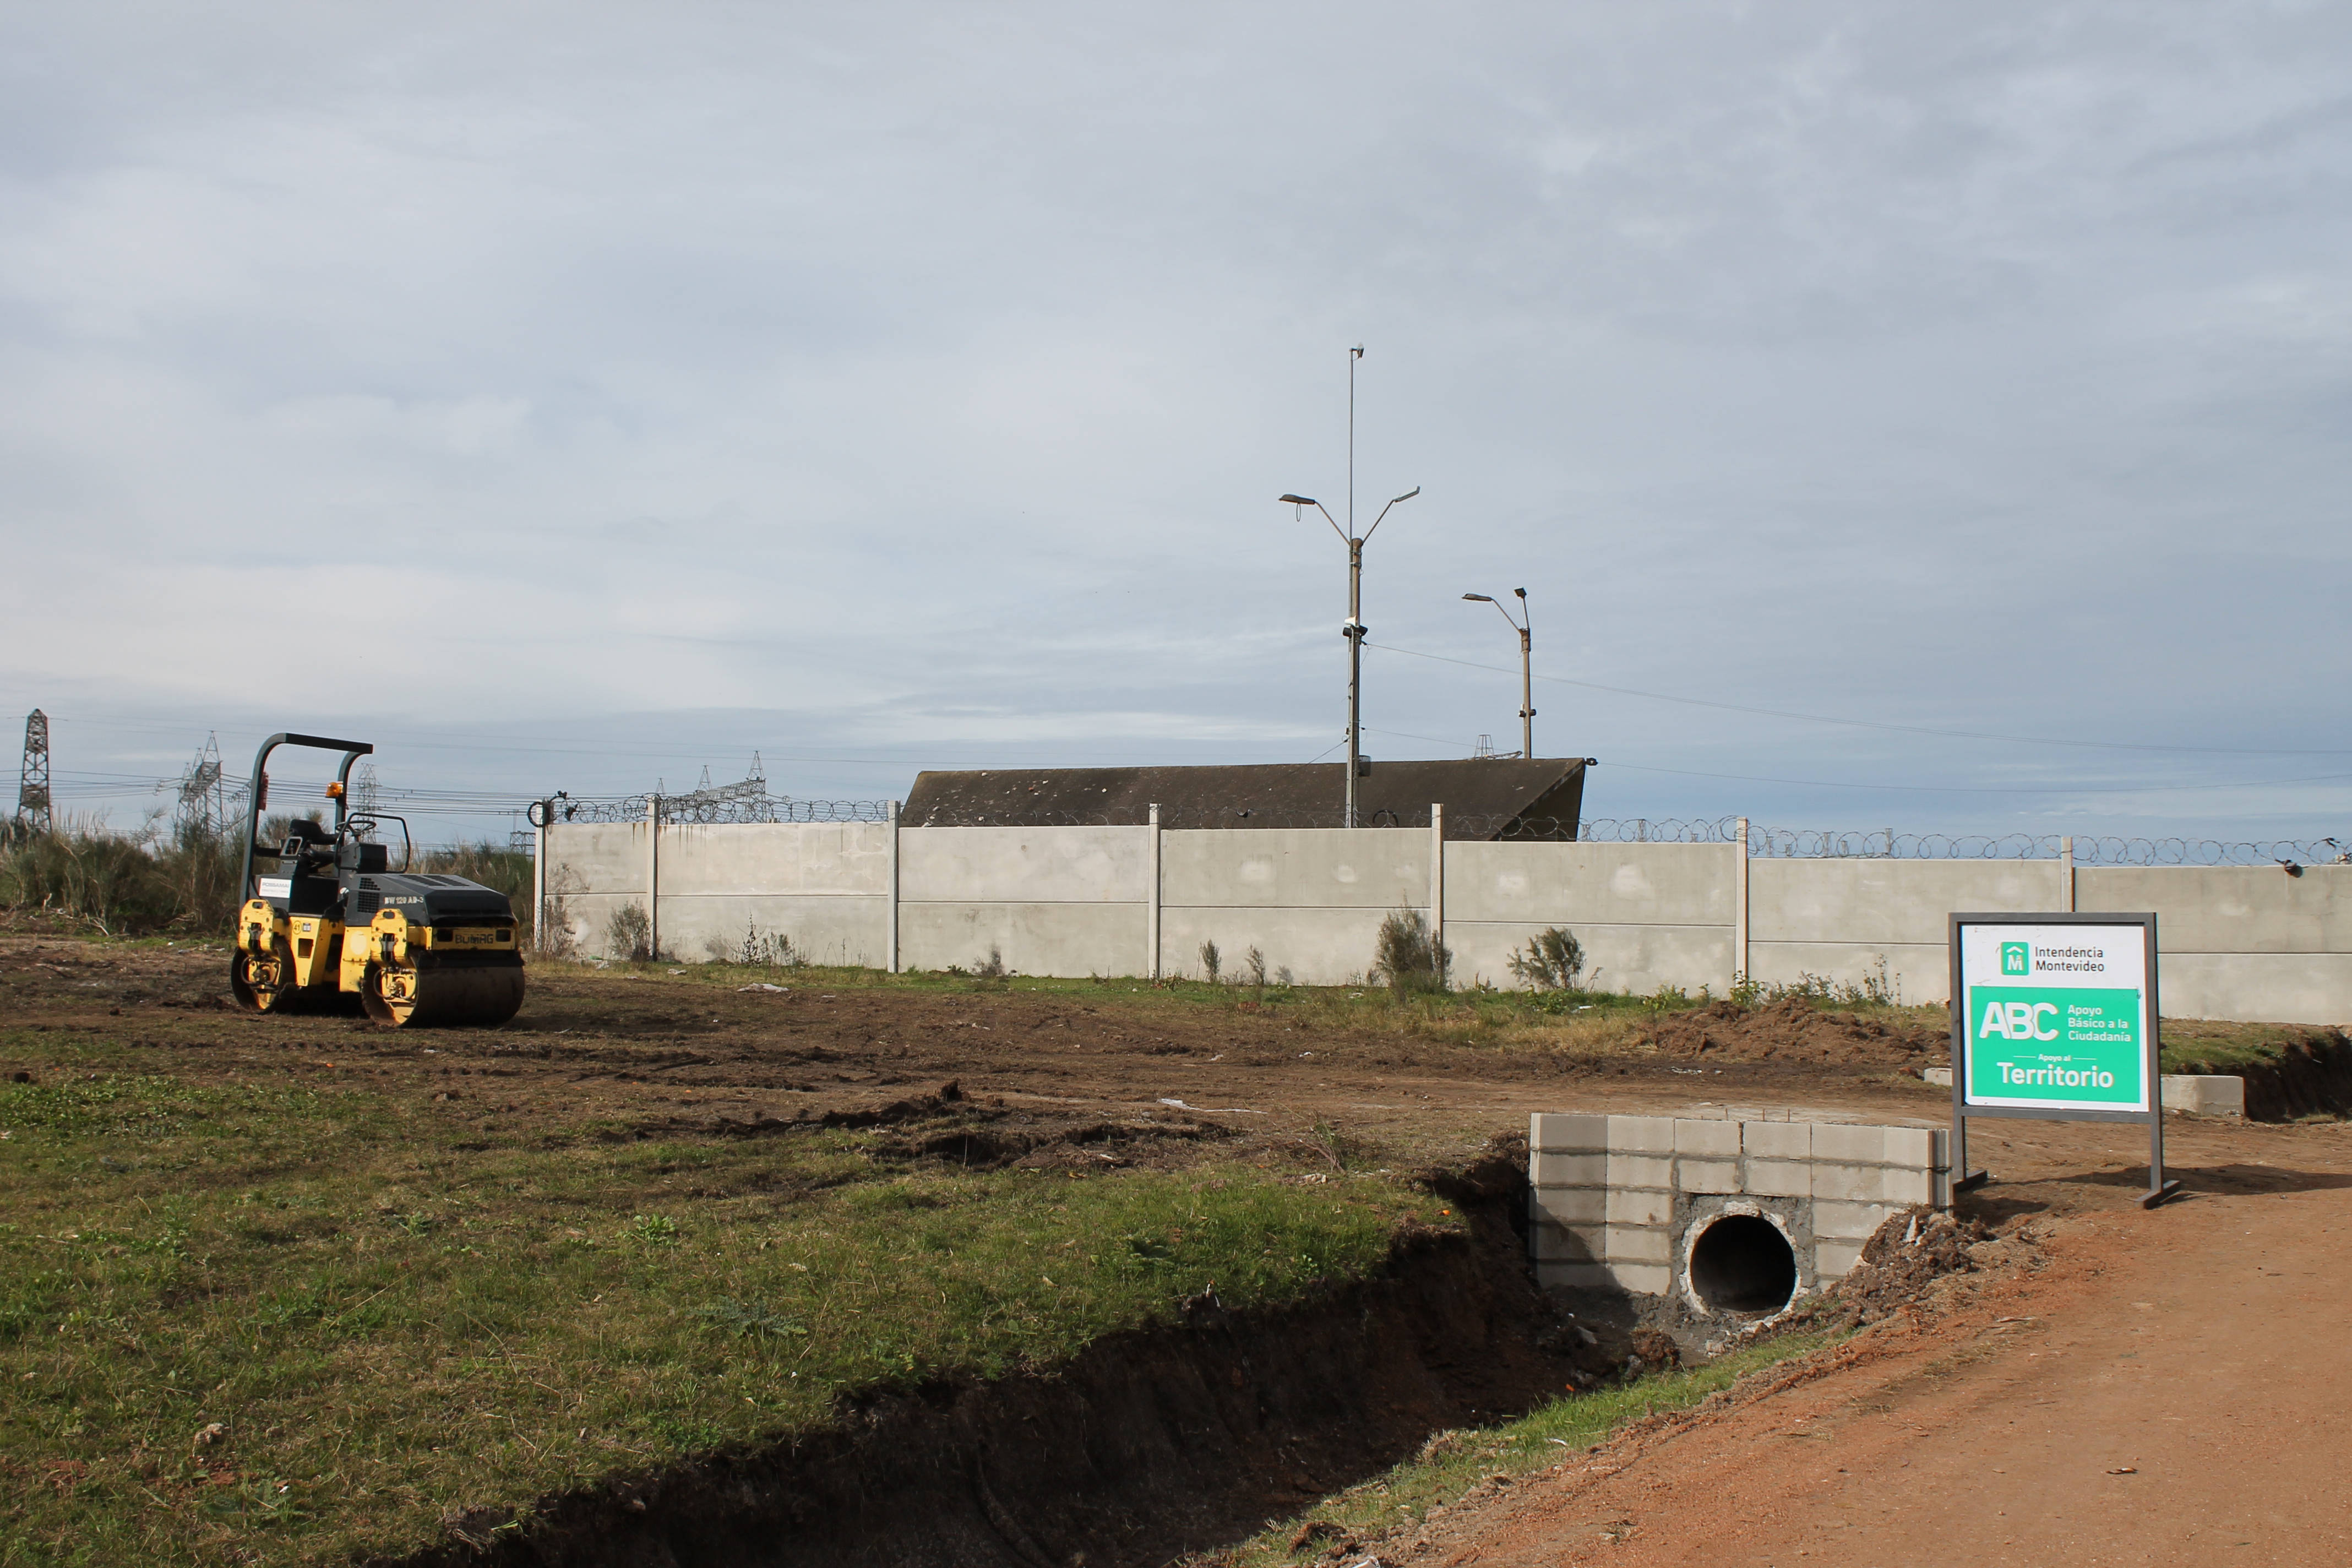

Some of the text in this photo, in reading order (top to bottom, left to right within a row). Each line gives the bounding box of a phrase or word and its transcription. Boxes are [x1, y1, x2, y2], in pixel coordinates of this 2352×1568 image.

[2035, 946, 2104, 958] Intendencia
[2035, 960, 2104, 972] Montevideo
[2067, 1004, 2103, 1017] Apoyo
[1979, 1001, 2060, 1042] ABC
[2068, 1016, 2129, 1028] Básico a la
[2068, 1030, 2132, 1042] Ciudadanía
[2038, 1053, 2062, 1062] Apoyo
[1996, 1061, 2115, 1088] Territorio
